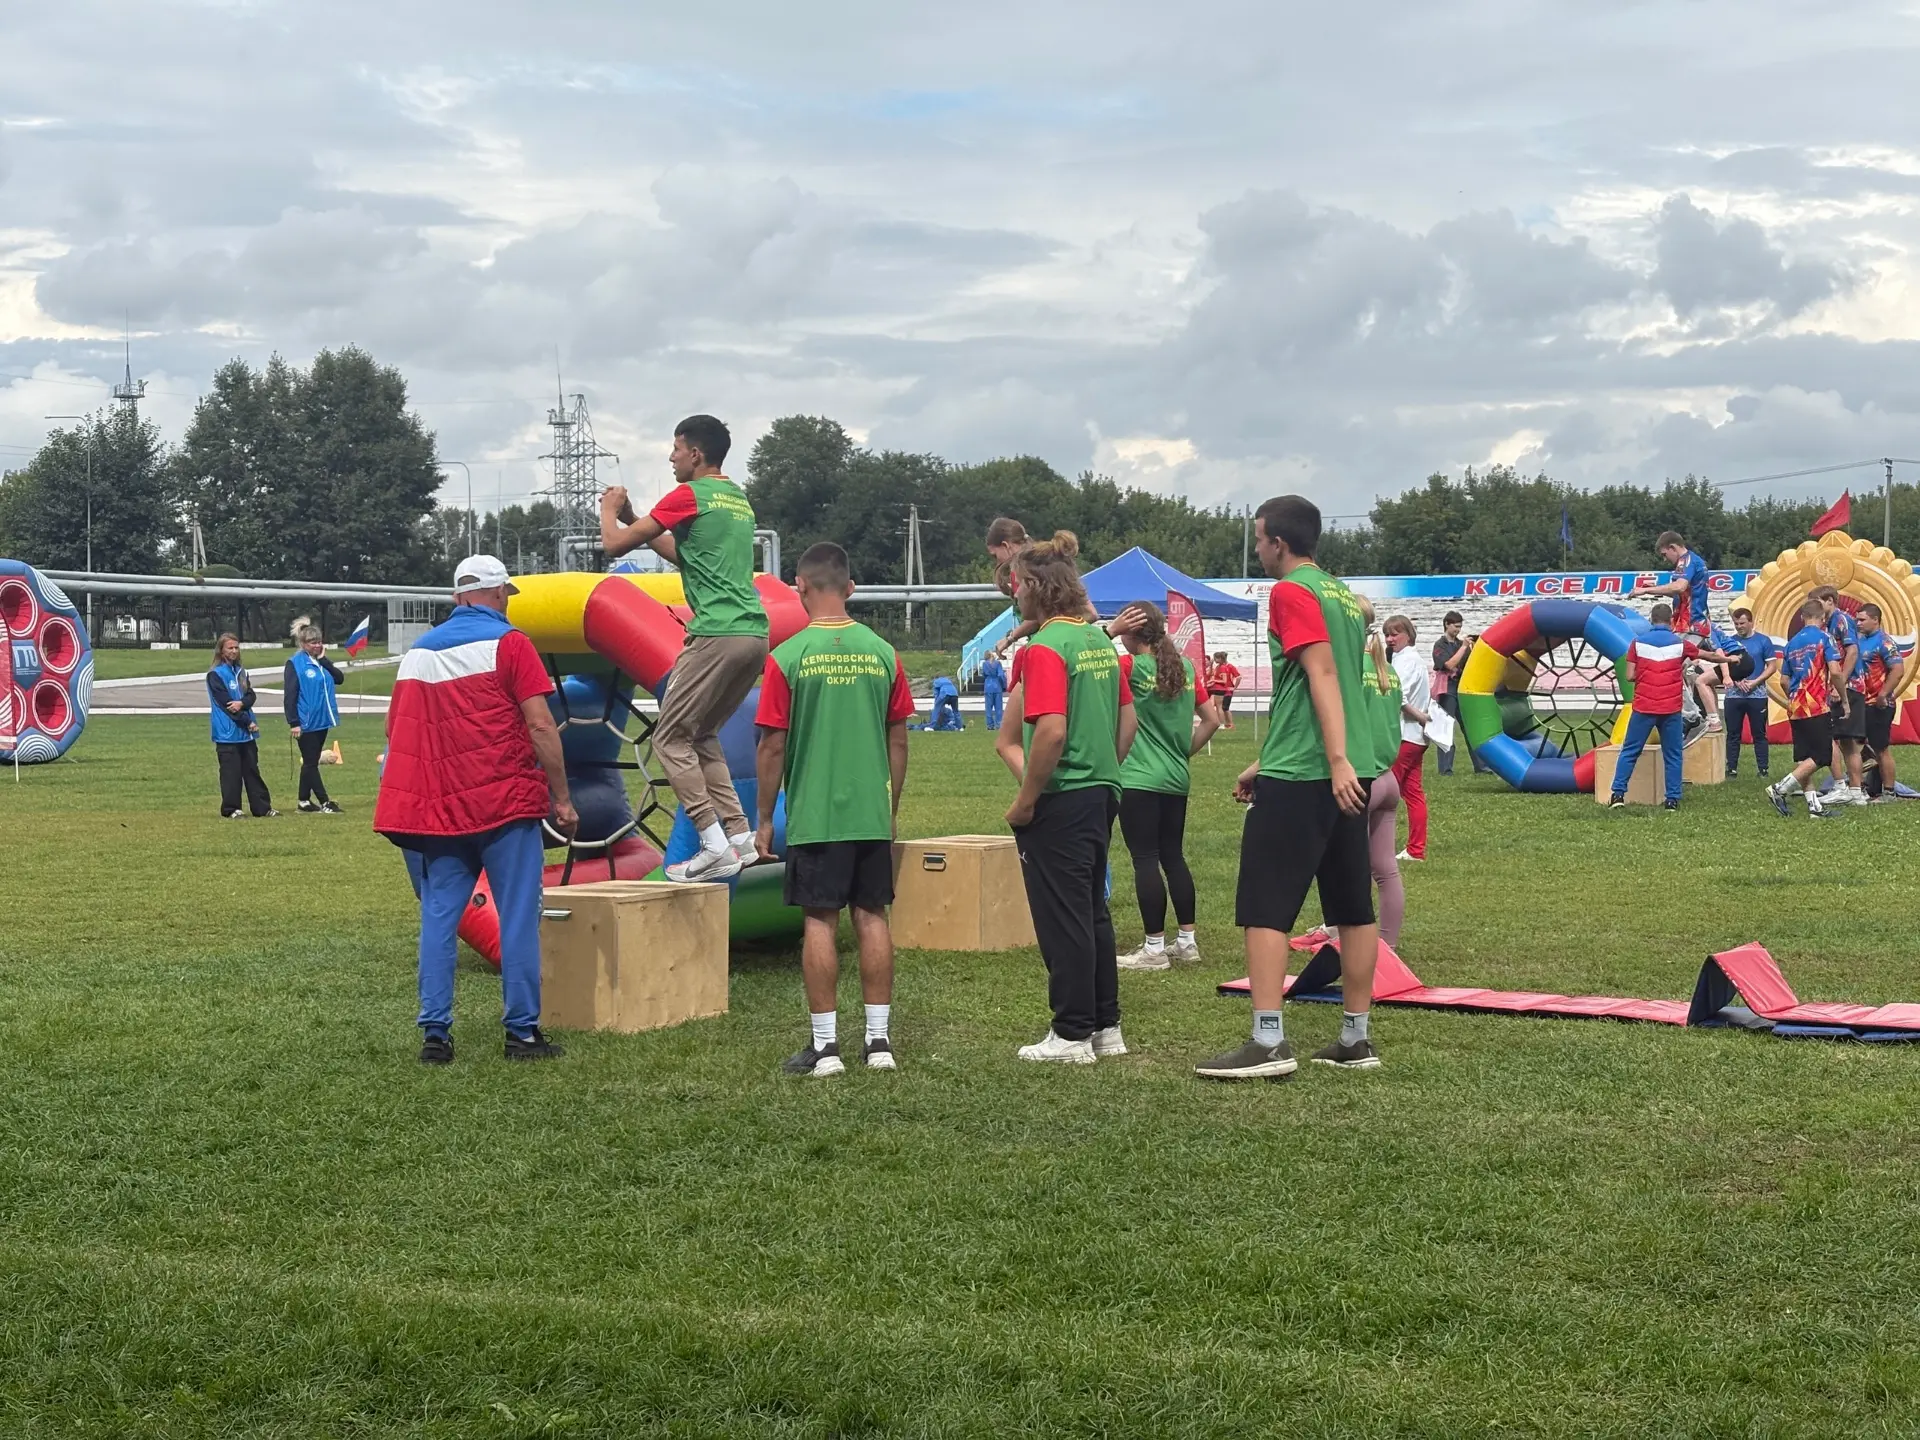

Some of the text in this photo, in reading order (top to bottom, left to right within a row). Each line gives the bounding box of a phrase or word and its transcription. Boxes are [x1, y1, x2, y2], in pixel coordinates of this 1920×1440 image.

[1464, 573, 1757, 596] КИСЕЛЁС
[11, 646, 38, 668] ГТО
[802, 654, 878, 666] КЕМЕРОВСКИЙ
[826, 676, 857, 685] ОКРУГ
